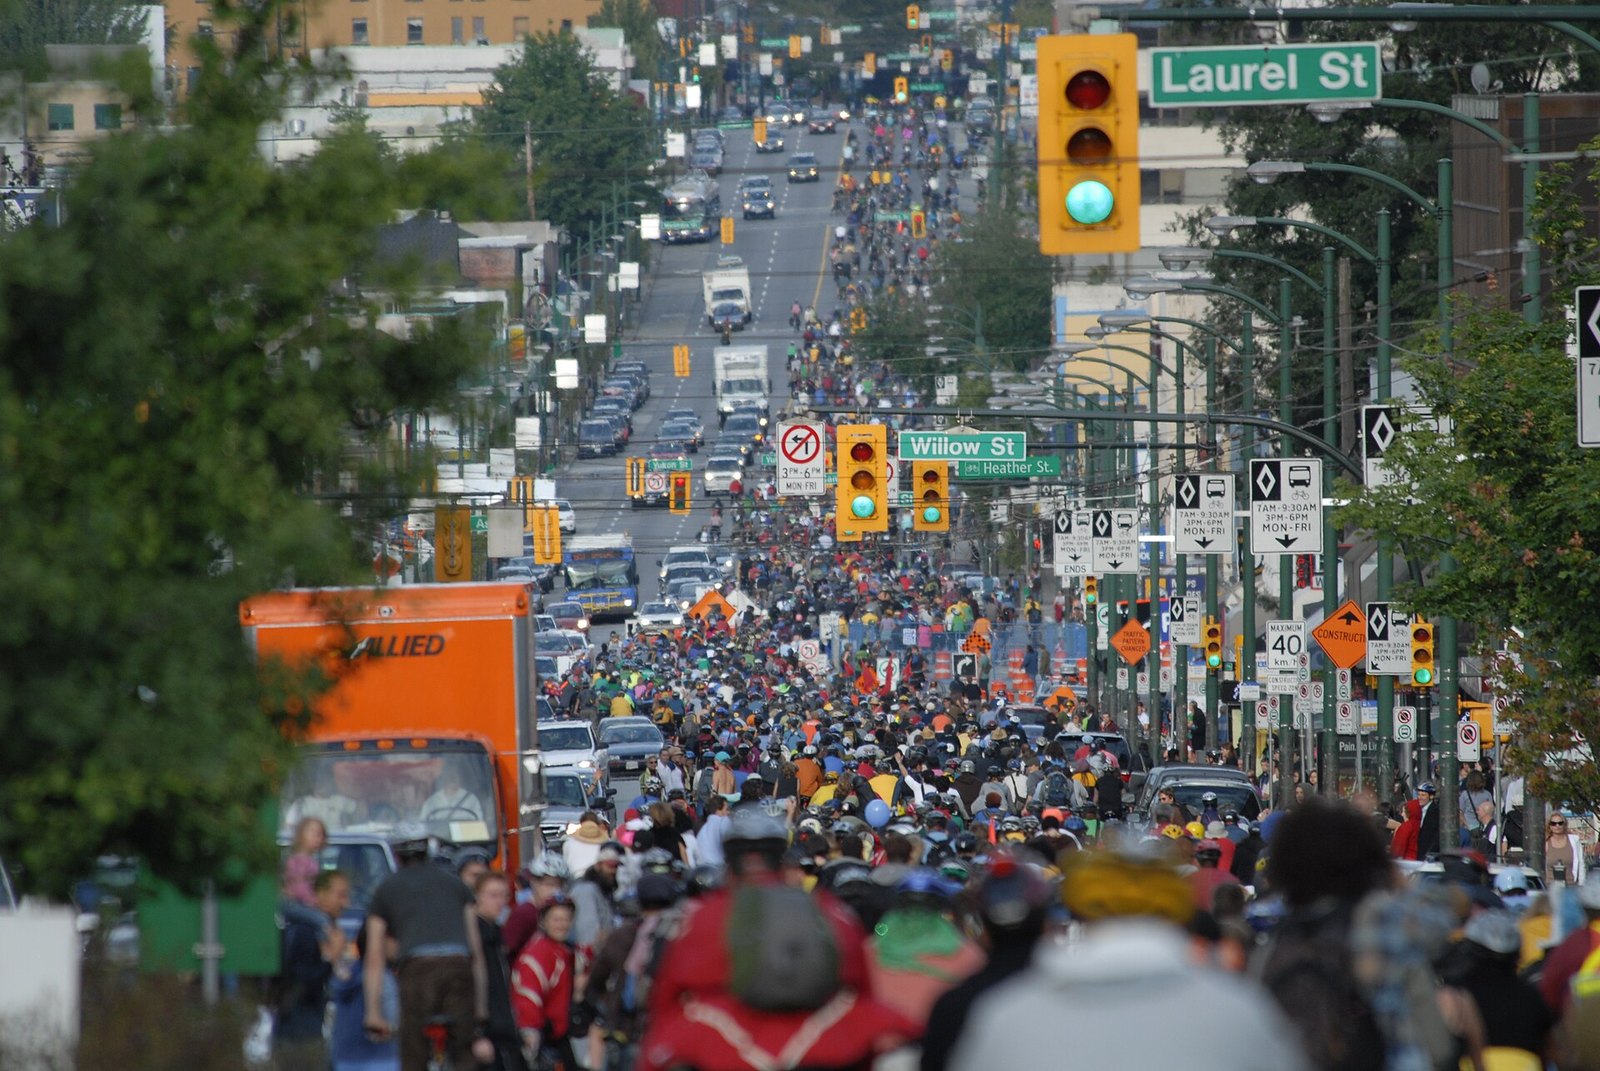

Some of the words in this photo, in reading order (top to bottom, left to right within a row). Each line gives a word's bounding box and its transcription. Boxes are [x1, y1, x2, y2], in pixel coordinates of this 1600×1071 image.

[1161, 53, 1298, 94] Laurel
[1319, 51, 1369, 91] St
[911, 437, 980, 457] Willow
[990, 437, 1016, 456] St
[652, 462, 677, 470] Yukon
[679, 461, 689, 469] St
[984, 461, 1031, 475] Heather
[1036, 459, 1054, 473] St.
[1064, 565, 1087, 574] ENDS
[351, 635, 446, 659] ALLIED
[1271, 634, 1302, 655] 40
